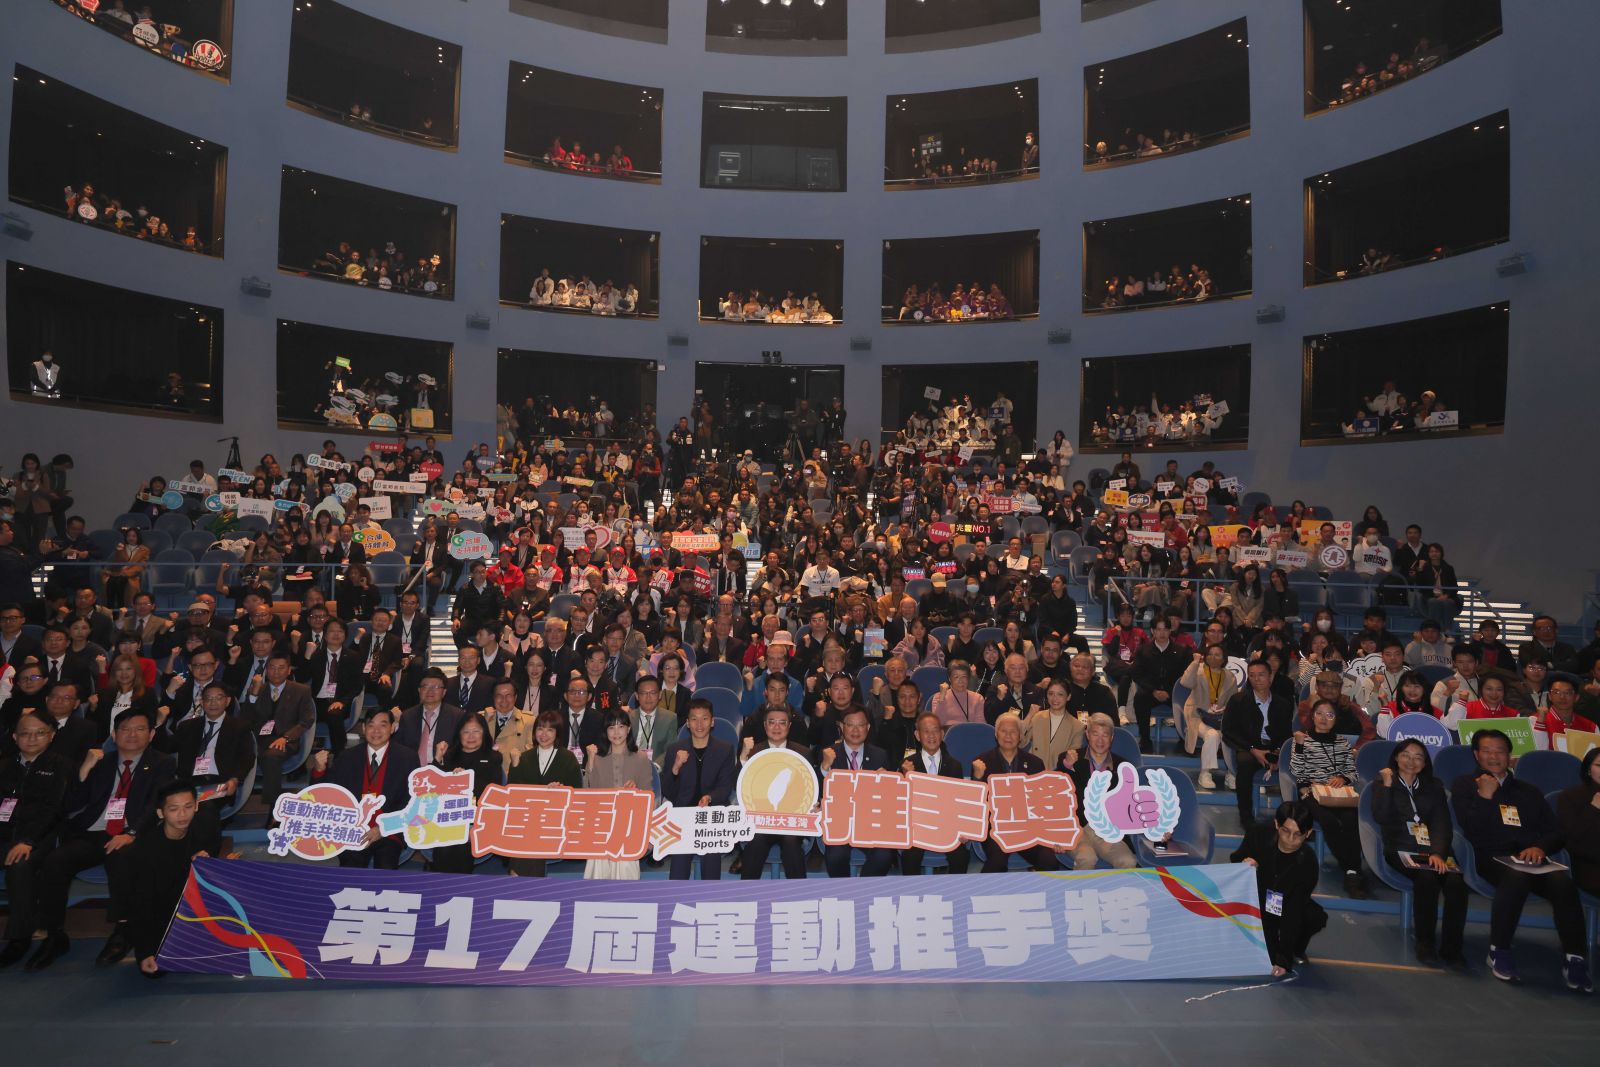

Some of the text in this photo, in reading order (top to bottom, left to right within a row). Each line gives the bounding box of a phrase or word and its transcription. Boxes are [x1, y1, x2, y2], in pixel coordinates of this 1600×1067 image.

[931, 528, 950, 538] SAMPO
[1395, 731, 1443, 746] Amway
[444, 798, 469, 809] 運動
[280, 799, 357, 825] 運動新紀元
[437, 809, 475, 823] 推手獎
[695, 810, 741, 824] 運動部
[478, 786, 652, 858] 運動
[287, 819, 363, 844] 推手共領航
[694, 827, 751, 838] Ministry of
[693, 840, 729, 850] Sports
[318, 887, 1153, 976] 第17屆運動推手獎
